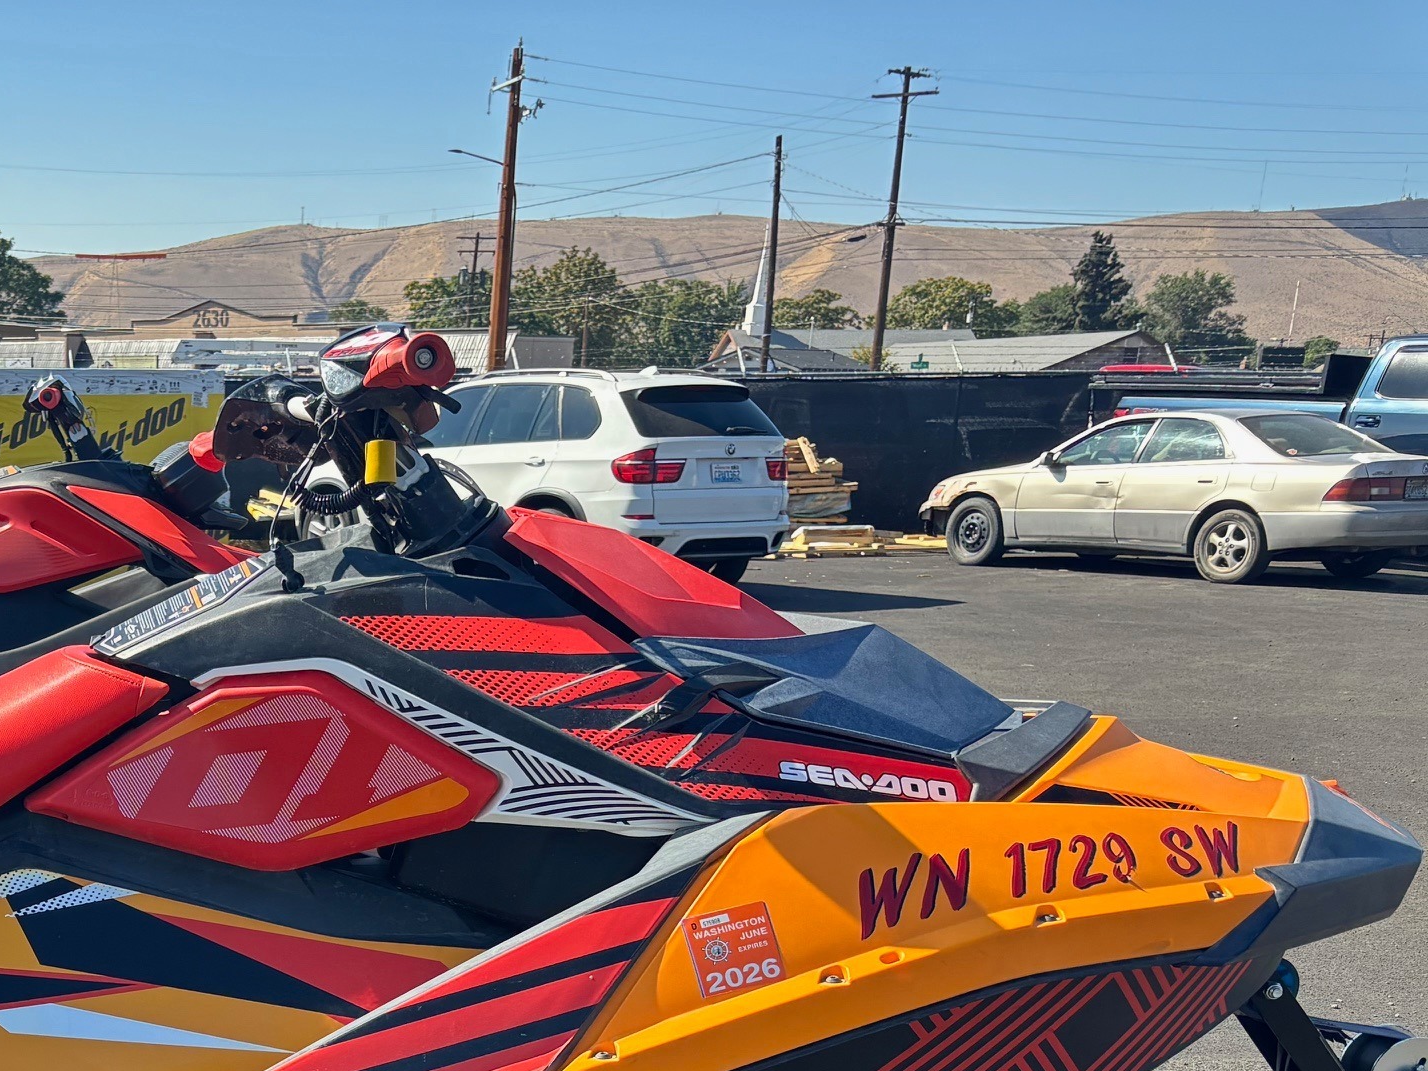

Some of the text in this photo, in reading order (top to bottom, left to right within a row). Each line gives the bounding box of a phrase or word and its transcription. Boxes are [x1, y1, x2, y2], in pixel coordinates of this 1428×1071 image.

[192, 309, 230, 328] 2630
[858, 820, 1240, 941] WN 1729 SW
[692, 915, 767, 940] WASHINGTON
[739, 926, 769, 941] JUNE
[737, 939, 770, 953] EXPIRES
[705, 957, 781, 994] 2026
